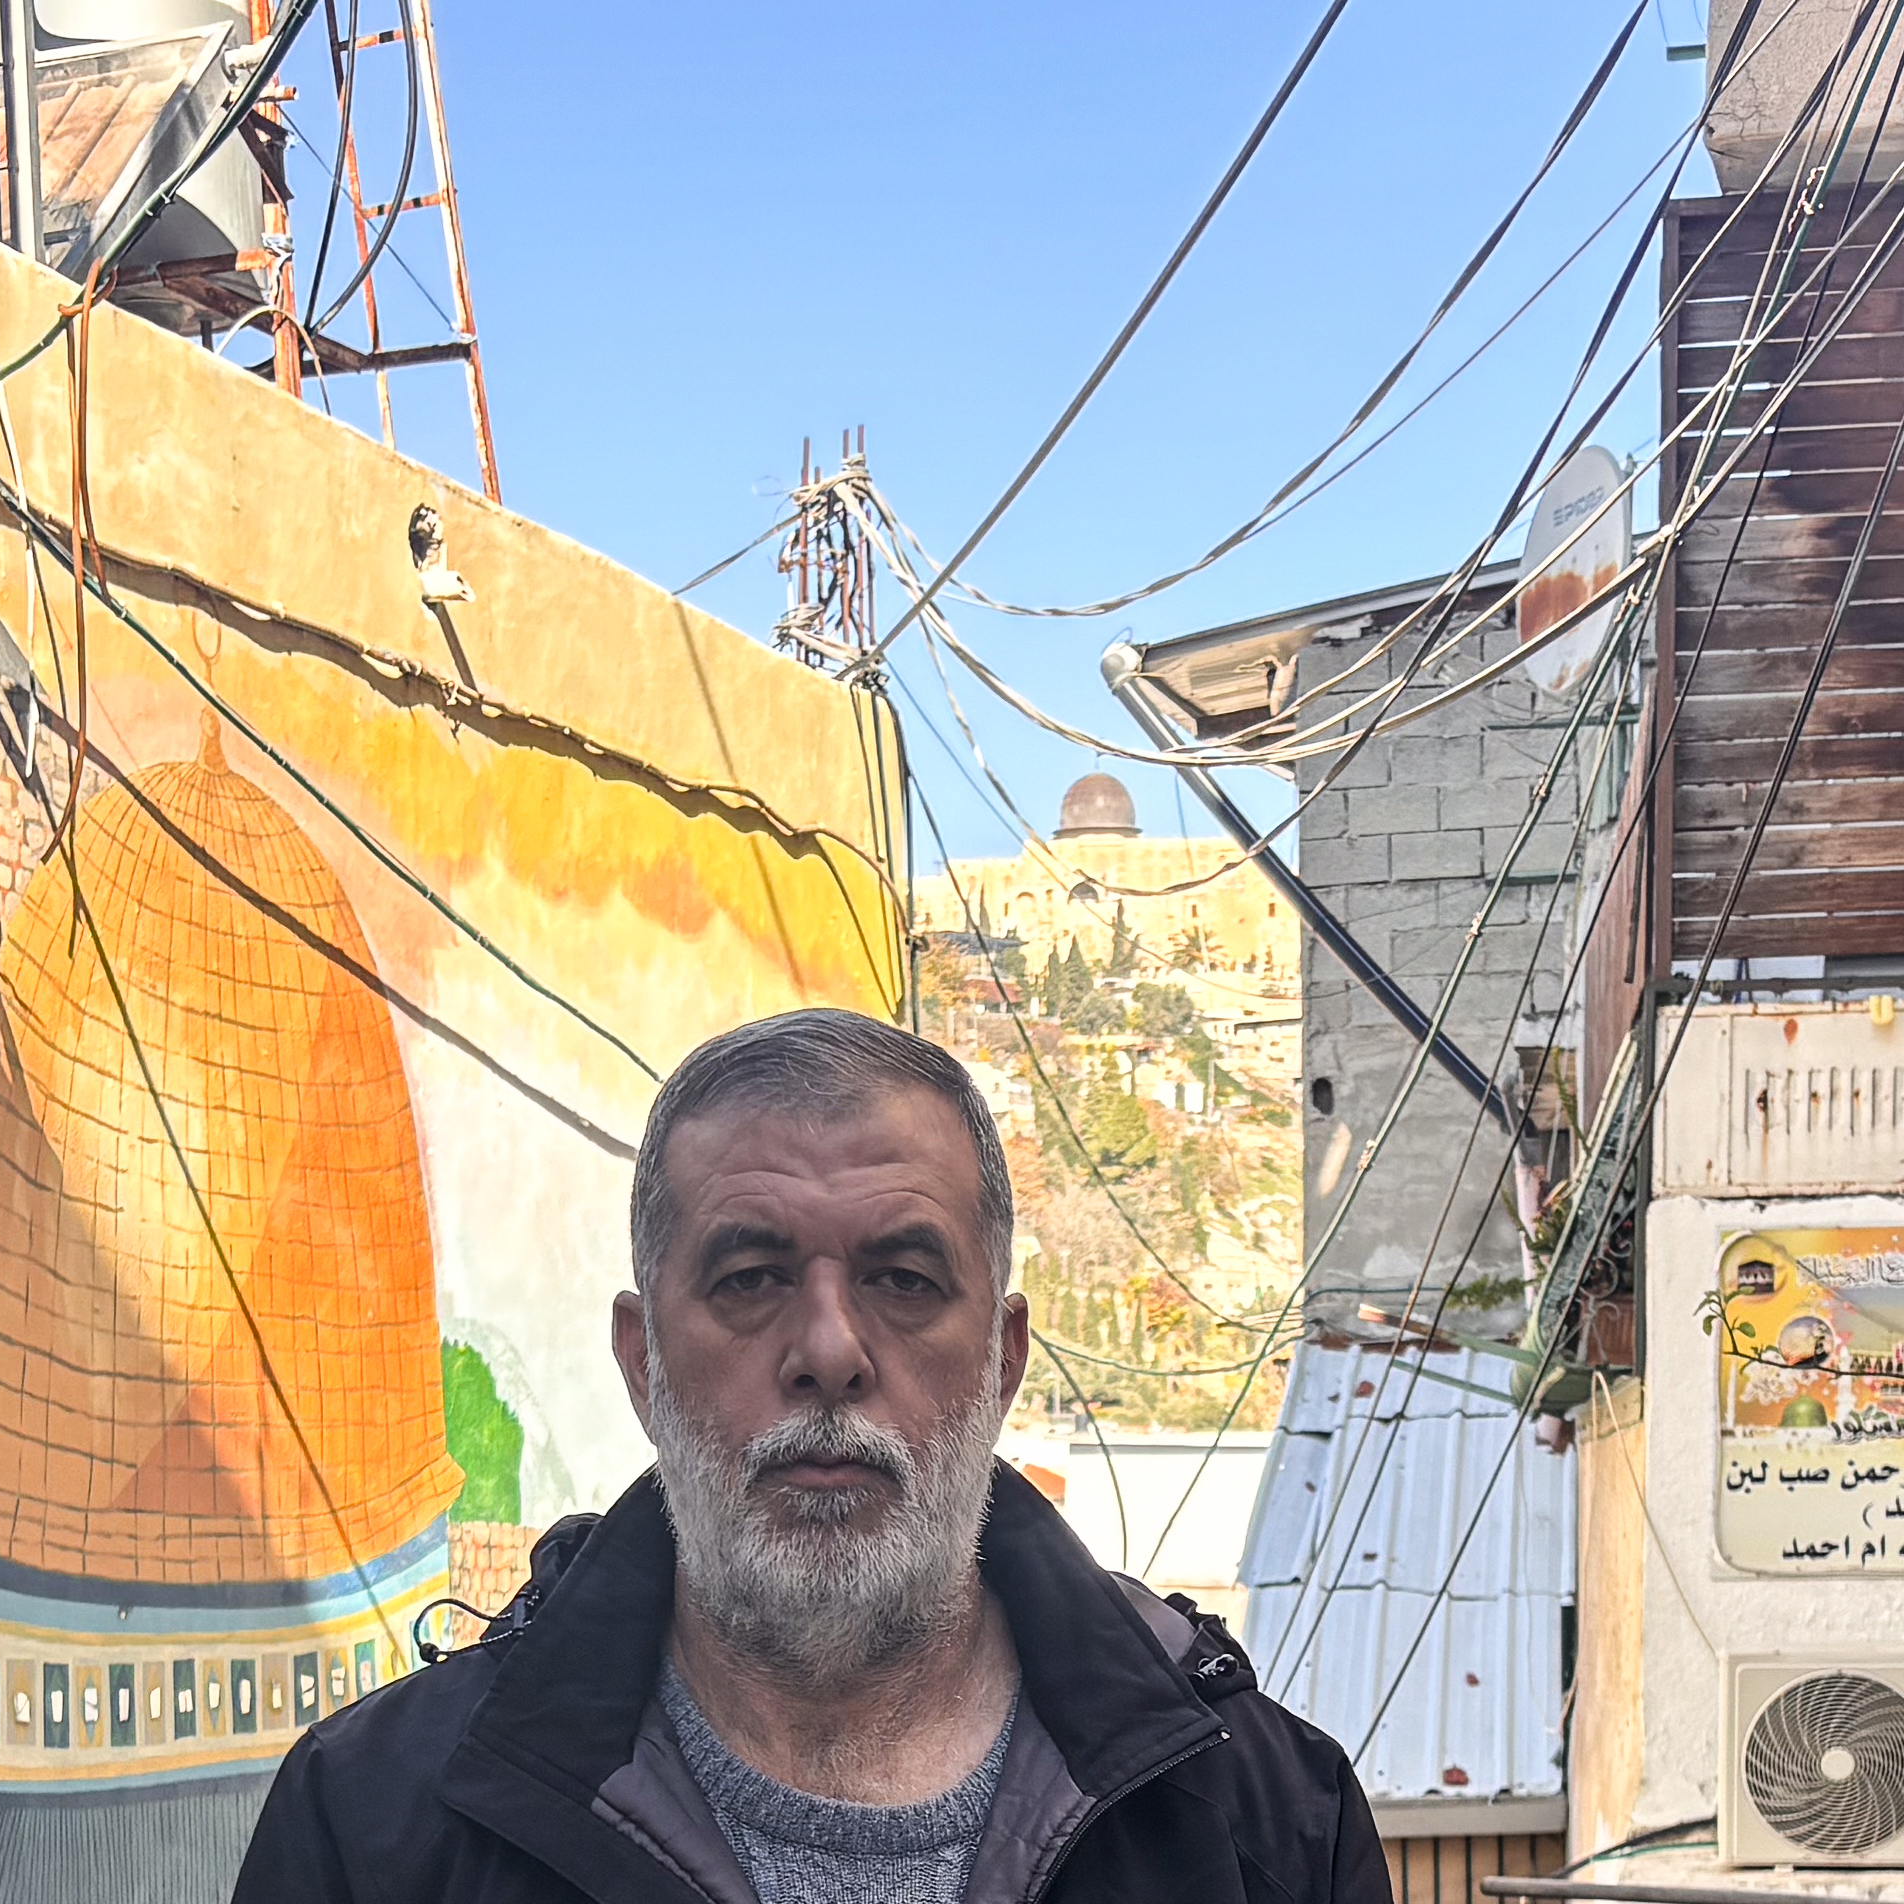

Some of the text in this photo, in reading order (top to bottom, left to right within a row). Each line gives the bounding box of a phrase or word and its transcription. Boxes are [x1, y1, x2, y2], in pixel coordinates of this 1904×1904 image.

[1727, 1460, 1768, 1493] لبن
[1779, 1466, 1830, 1492] صب
[1782, 1534, 1849, 1559] احمد
[1861, 1534, 1886, 1566] ام
